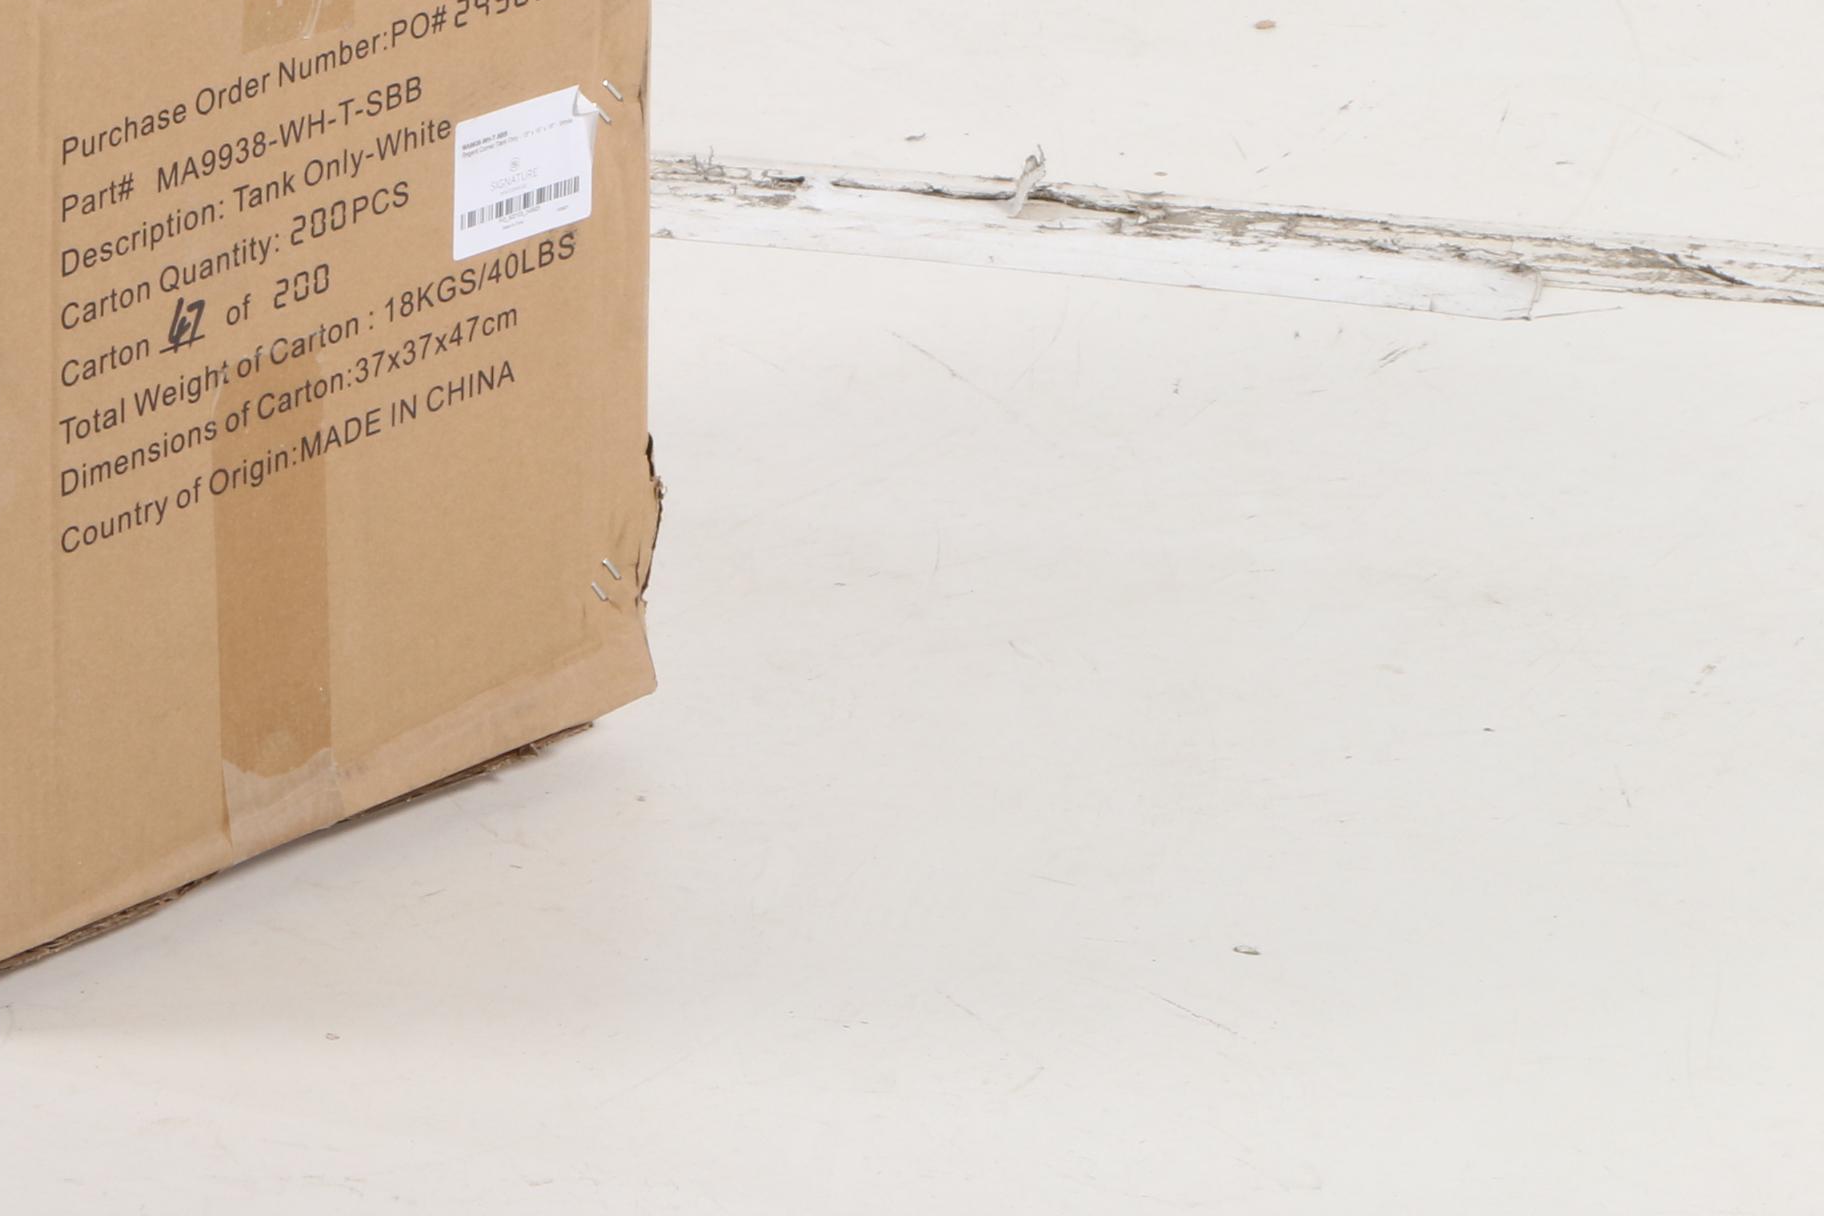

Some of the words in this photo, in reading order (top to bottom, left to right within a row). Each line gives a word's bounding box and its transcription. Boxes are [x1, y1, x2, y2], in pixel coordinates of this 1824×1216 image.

[61, 103, 187, 166] Purchase
[195, 72, 271, 116] Order
[61, 171, 135, 224] Part#
[157, 75, 422, 194] MA9938-WH-T-SBB
[61, 199, 225, 278] Description:
[232, 170, 296, 213] Tank
[303, 119, 452, 187] Only-White
[58, 397, 125, 445] Total
[133, 359, 230, 417] Weight
[236, 344, 264, 379] of
[269, 317, 359, 366] Carton
[384, 230, 576, 323] 18KGS/40LBS
[60, 281, 151, 331] Carton
[159, 233, 280, 293] Quantity:
[60, 338, 150, 388] Carton
[225, 292, 252, 326] of
[273, 263, 330, 310] 200
[60, 420, 218, 498] Dimensions
[224, 399, 251, 433] of
[60, 495, 169, 554] Country
[175, 475, 203, 510] of
[391, 393, 417, 428] IN
[426, 359, 516, 413] CHINA
